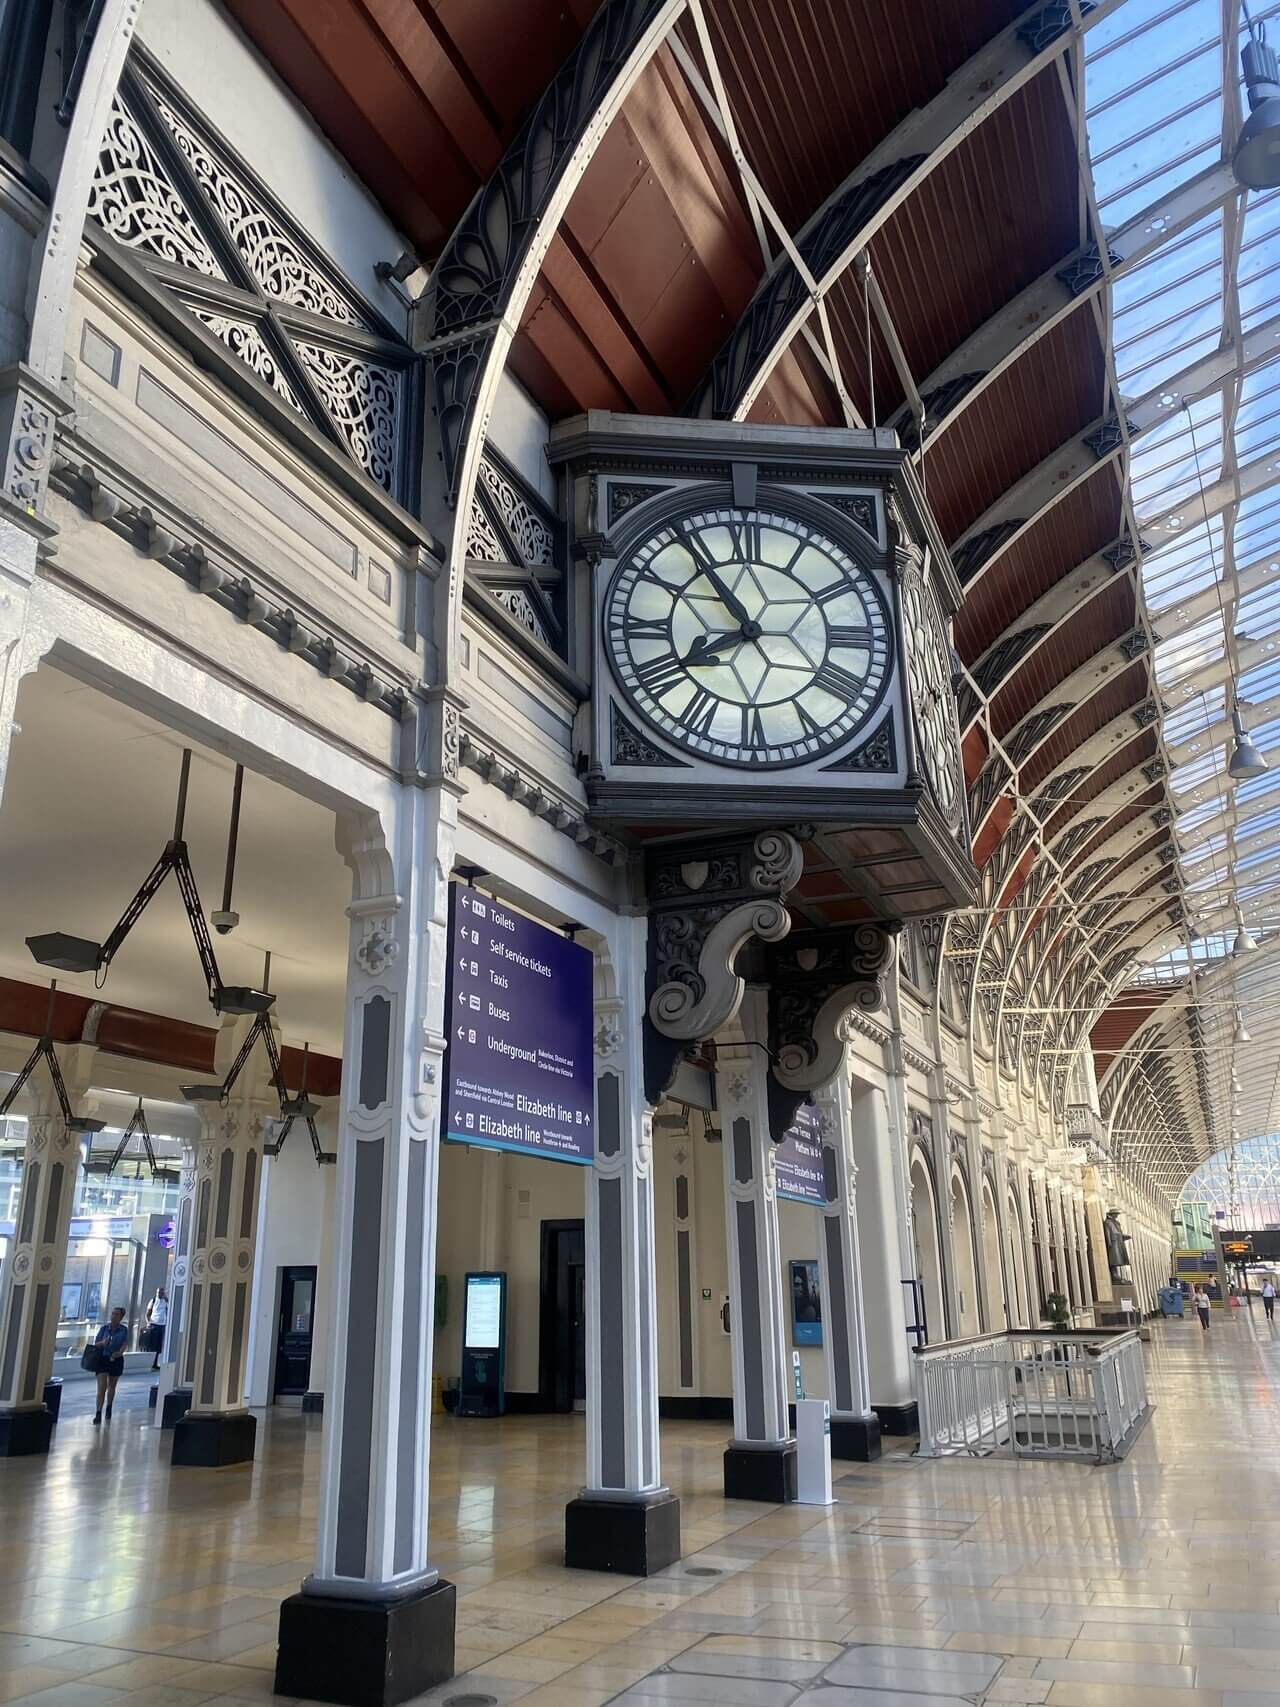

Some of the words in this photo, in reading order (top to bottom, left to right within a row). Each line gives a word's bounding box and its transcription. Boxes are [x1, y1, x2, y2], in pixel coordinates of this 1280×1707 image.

[728, 523, 761, 562] XII
[637, 567, 684, 598] X
[809, 578, 864, 606] II
[624, 616, 673, 640] IX
[826, 625, 873, 650] III
[740, 706, 769, 748] VI
[490, 909, 516, 932] Toilets
[490, 939, 505, 956] Self
[505, 947, 530, 968] service
[530, 959, 552, 978] tickets
[489, 969, 509, 989] Taxis
[488, 1002, 510, 1021] Buses
[487, 1035, 537, 1063] Underground
[517, 1094, 556, 1119] Elizabeth
[557, 1103, 572, 1123] line
[479, 1114, 523, 1140] Elizabeth
[524, 1124, 541, 1143] line
[782, 1178, 799, 1192] Elizabeth
[794, 1165, 810, 1179] Elizabeth
